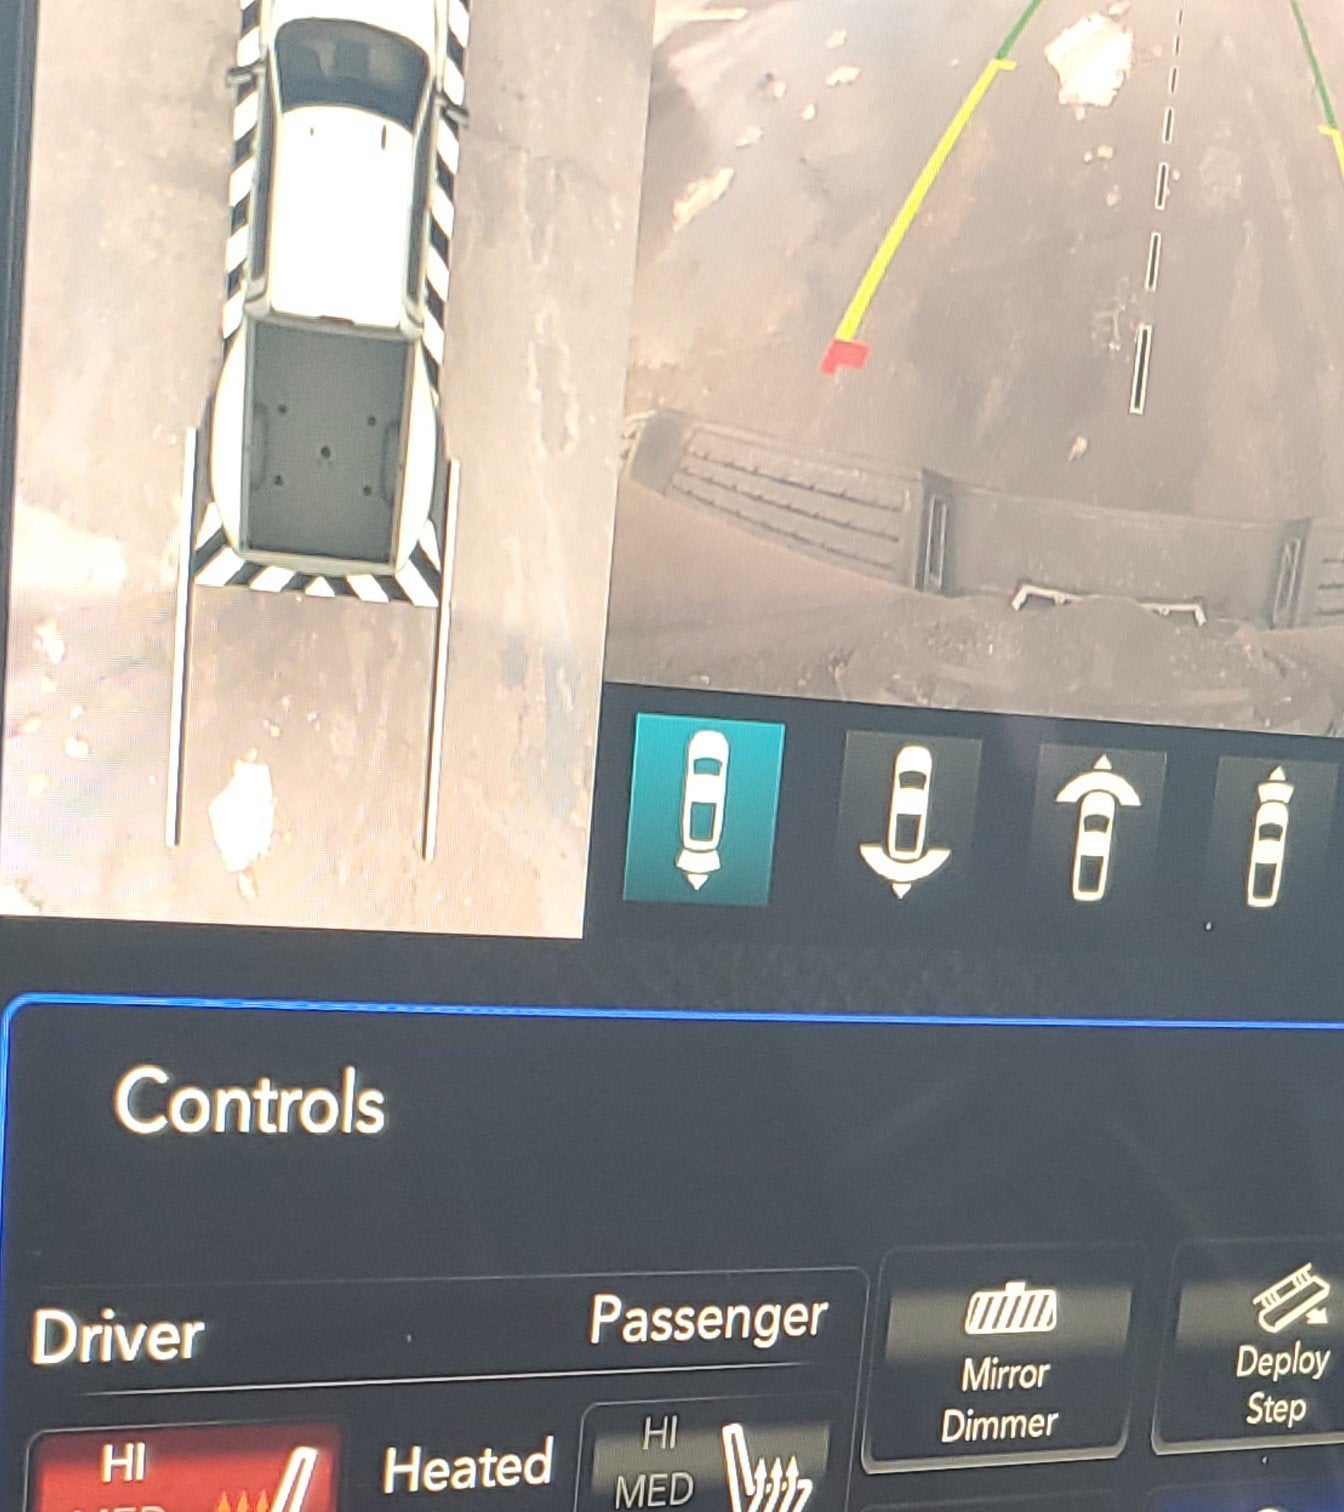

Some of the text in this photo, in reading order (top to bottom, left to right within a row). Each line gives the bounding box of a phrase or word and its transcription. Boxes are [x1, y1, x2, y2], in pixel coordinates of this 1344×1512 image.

[114, 1064, 386, 1137] Controls
[31, 1309, 205, 1366] Driver
[590, 1293, 828, 1349] Passenger
[962, 1359, 1050, 1392] Mirror
[1235, 1341, 1330, 1380] Deploy
[941, 1409, 1058, 1443] Dimmer
[1245, 1391, 1307, 1426] Step
[643, 1417, 678, 1451] HI
[101, 1444, 146, 1483] HI
[384, 1437, 554, 1495] Heated
[615, 1472, 694, 1510] MED
